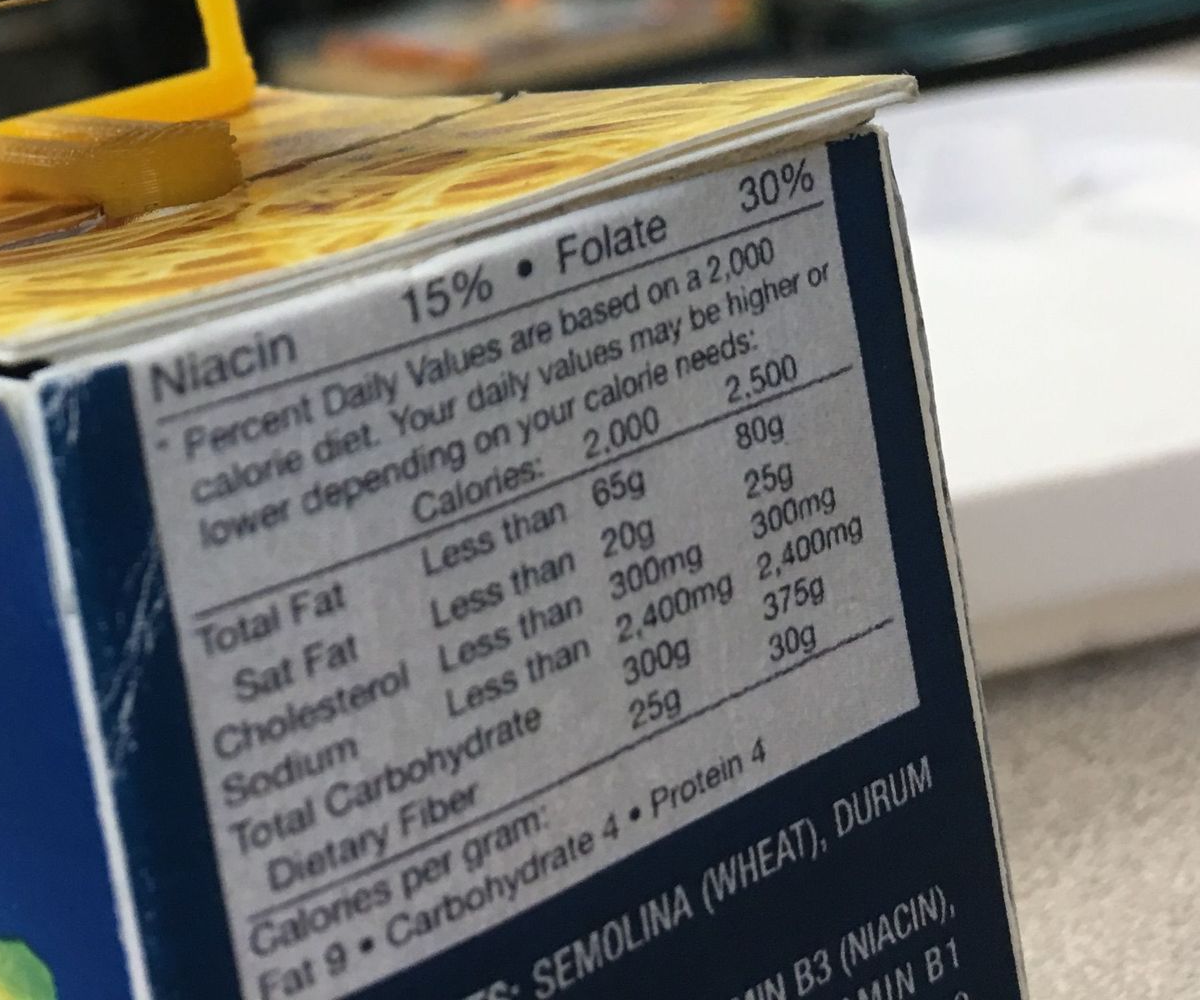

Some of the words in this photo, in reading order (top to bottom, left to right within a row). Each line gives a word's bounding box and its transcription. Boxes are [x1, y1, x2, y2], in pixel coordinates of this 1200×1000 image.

[152, 331, 297, 402] Niacin
[402, 264, 493, 323] 15%
[556, 215, 667, 274] Folate
[738, 158, 815, 213] 30%
[184, 398, 314, 459] Percent
[322, 371, 399, 416] Daily
[405, 337, 503, 388] Values
[510, 321, 553, 354] are
[560, 290, 640, 337] based
[647, 279, 679, 305] on
[686, 271, 702, 292] a
[706, 236, 775, 285] 2,000
[191, 449, 304, 505] calorie
[313, 423, 381, 466] diet.
[390, 397, 456, 436] Your
[467, 364, 532, 412] daily
[537, 338, 623, 386] values
[630, 315, 683, 353] may
[689, 300, 721, 332] be
[728, 271, 800, 316] higher
[807, 263, 830, 287] or
[195, 602, 280, 658] Total
[290, 582, 345, 626] Fat
[421, 529, 495, 577] Less
[502, 501, 567, 545] than
[592, 469, 646, 508] 65g
[735, 413, 785, 450] 80g
[199, 497, 291, 550] lower
[301, 437, 466, 516] depending
[474, 424, 511, 455] on
[517, 399, 576, 447] your
[583, 360, 669, 412] calorie
[675, 330, 758, 379] needs:
[412, 457, 544, 524] Calories:
[213, 658, 411, 761] Cholesterol
[438, 626, 512, 674] Less
[518, 595, 584, 640] than
[608, 543, 703, 601] 300mg
[750, 485, 837, 540] 300mg
[222, 735, 359, 809] Sodium
[446, 668, 519, 717] Less
[525, 638, 591, 683] than
[756, 515, 863, 581] 2,400mg
[234, 656, 294, 702] Sat
[303, 632, 358, 677] Fat
[430, 581, 504, 628] Less
[510, 551, 576, 595] than
[600, 519, 655, 558] 20g
[744, 462, 795, 500] 25g
[229, 798, 316, 856] Total
[324, 705, 543, 818] Carbohydrate
[623, 637, 691, 686] 300g
[763, 575, 825, 621] 375g
[267, 822, 390, 892] Dietary
[400, 783, 479, 837] Fiber
[628, 687, 682, 730] 25g
[769, 623, 817, 662] 30g
[250, 879, 393, 956] Calories
[402, 850, 452, 900] per
[461, 804, 549, 873] gram:
[258, 958, 316, 1000] Fat
[323, 941, 348, 977] 9
[385, 829, 597, 949] Carbohydrate
[602, 813, 620, 840] 4
[650, 755, 744, 818] Protein
[751, 736, 767, 764] 4
[532, 883, 695, 1000] SEMOLINA
[701, 816, 829, 915] (WHEAT),
[832, 755, 935, 838] DURUM
[794, 948, 832, 997] B3
[840, 884, 956, 977] (NIACIN),
